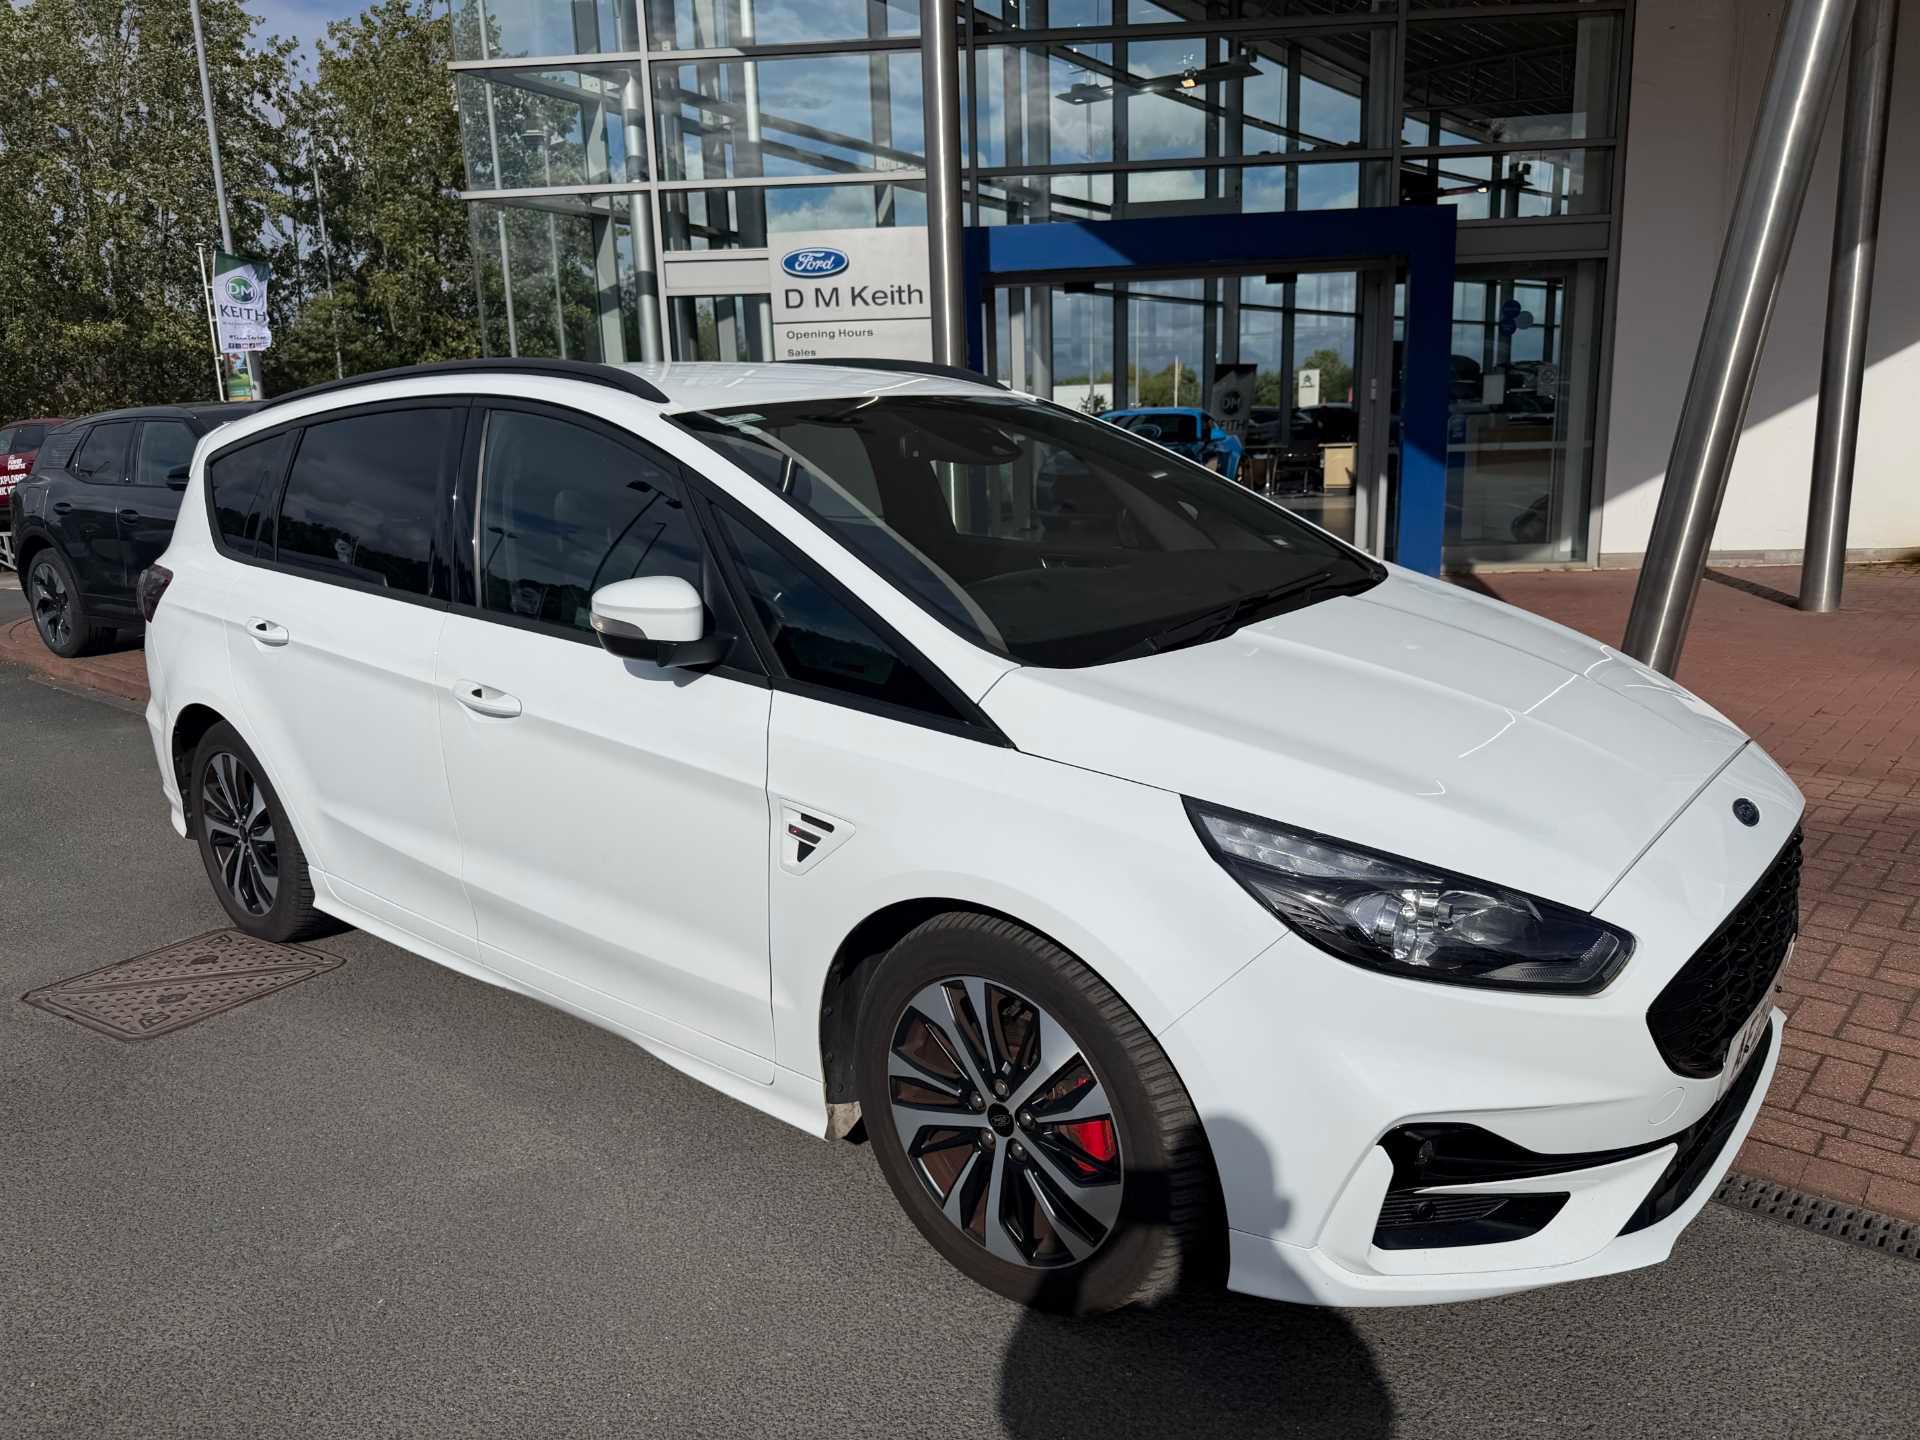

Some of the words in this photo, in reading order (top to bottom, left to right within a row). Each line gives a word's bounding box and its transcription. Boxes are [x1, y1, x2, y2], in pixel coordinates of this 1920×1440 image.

[228, 283, 254, 298] DM
[784, 288, 804, 310] D
[815, 287, 841, 308] M
[850, 284, 923, 307] Keith
[220, 304, 266, 321] KEITH
[786, 330, 836, 340] Opening
[838, 329, 874, 338] Hours
[787, 349, 817, 358] Sales
